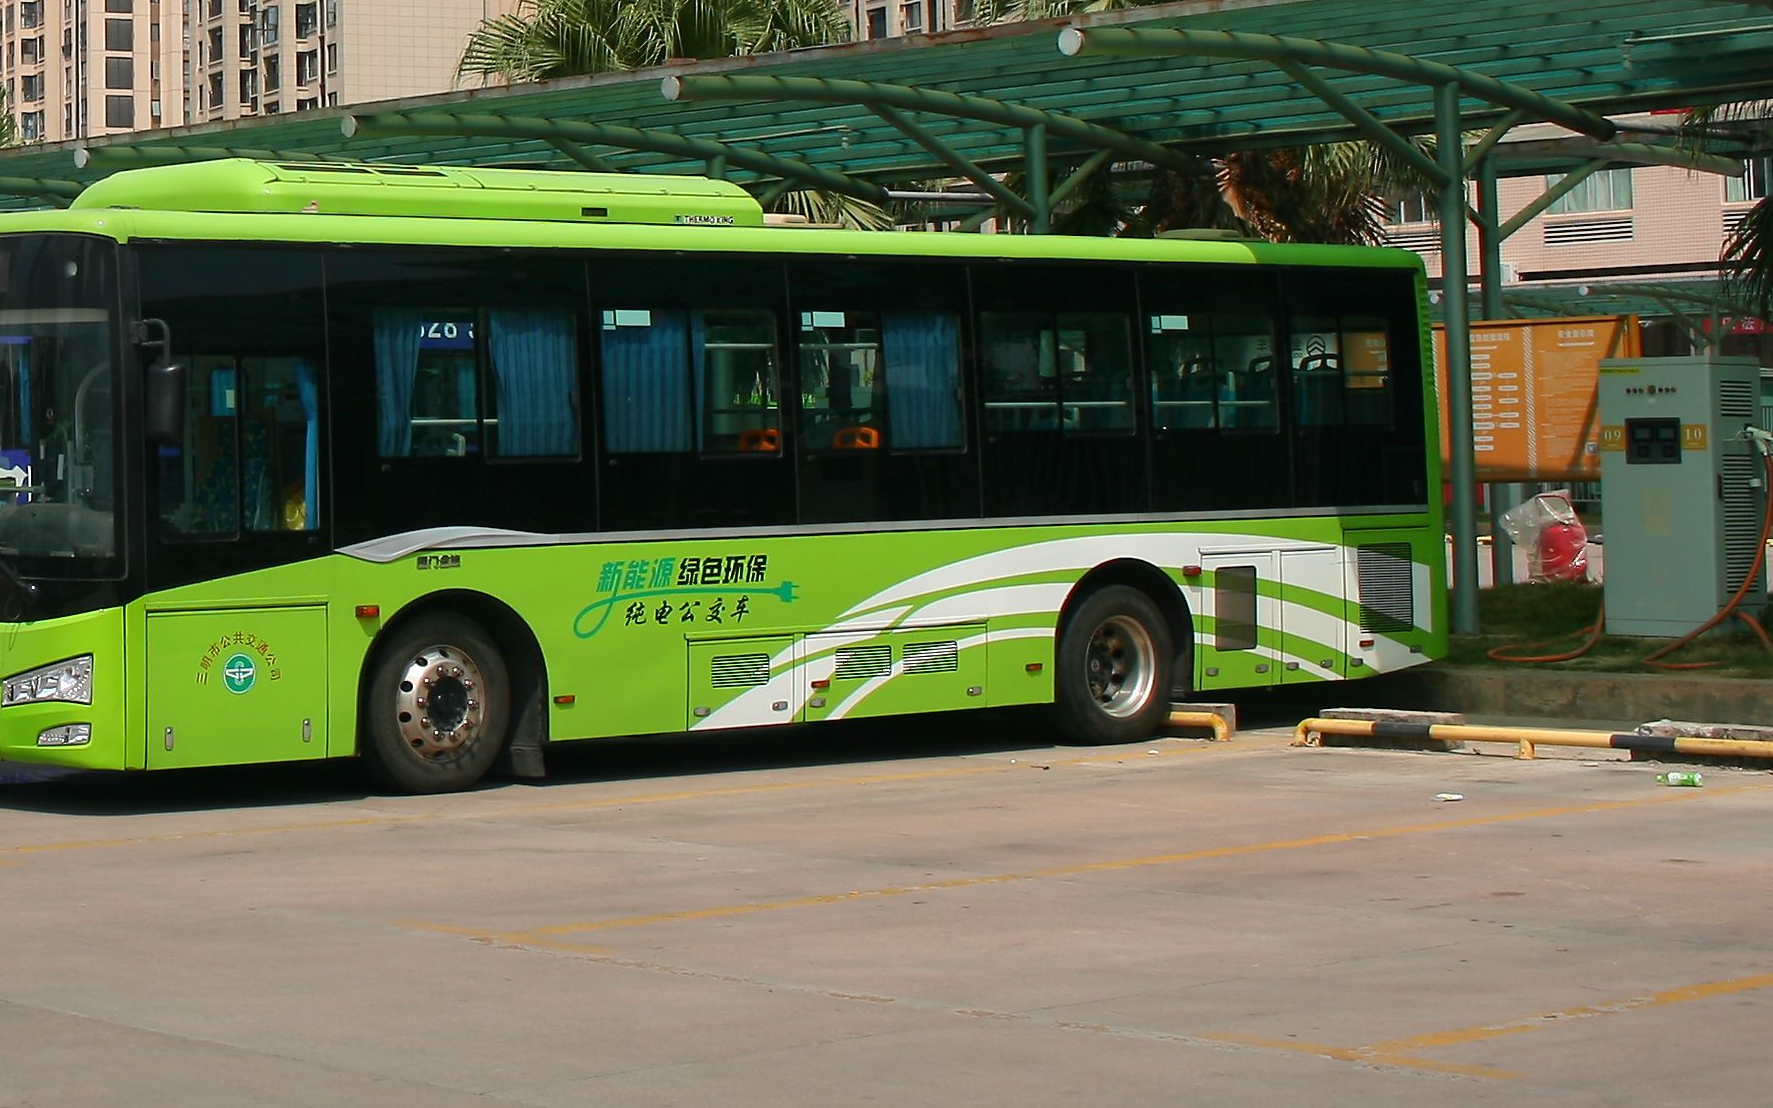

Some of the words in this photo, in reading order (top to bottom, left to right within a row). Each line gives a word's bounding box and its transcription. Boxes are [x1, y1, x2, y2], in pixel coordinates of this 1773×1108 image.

[1604, 430, 1621, 440] 09
[1685, 429, 1702, 439] 10
[596, 557, 676, 592] 新能源
[677, 554, 768, 586] 绿色环保
[625, 594, 750, 627] 纯电公交车
[195, 630, 282, 685] 三明市公共交通公司
